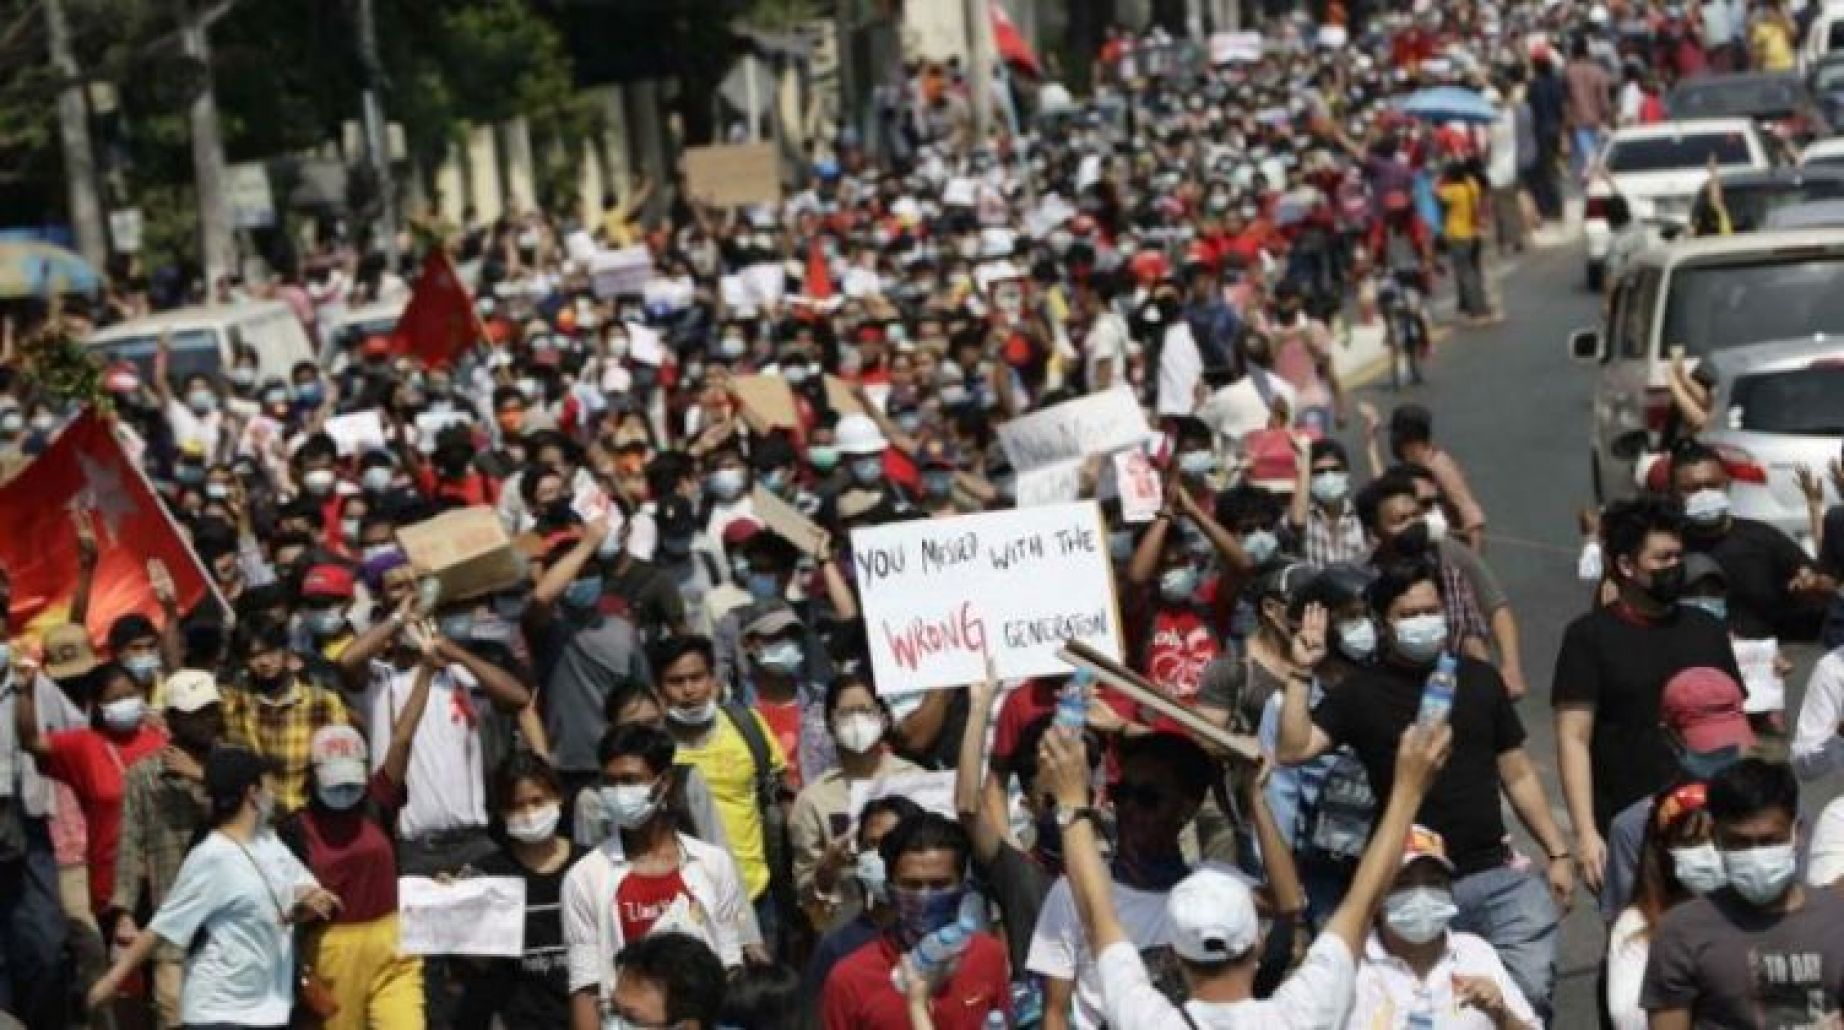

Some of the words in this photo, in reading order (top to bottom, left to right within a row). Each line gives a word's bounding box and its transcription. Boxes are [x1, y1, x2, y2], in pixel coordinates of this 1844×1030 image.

[857, 542, 905, 587] YOU
[989, 535, 1043, 570] WITH
[1055, 524, 1096, 555] THE
[882, 602, 988, 671] WRONG
